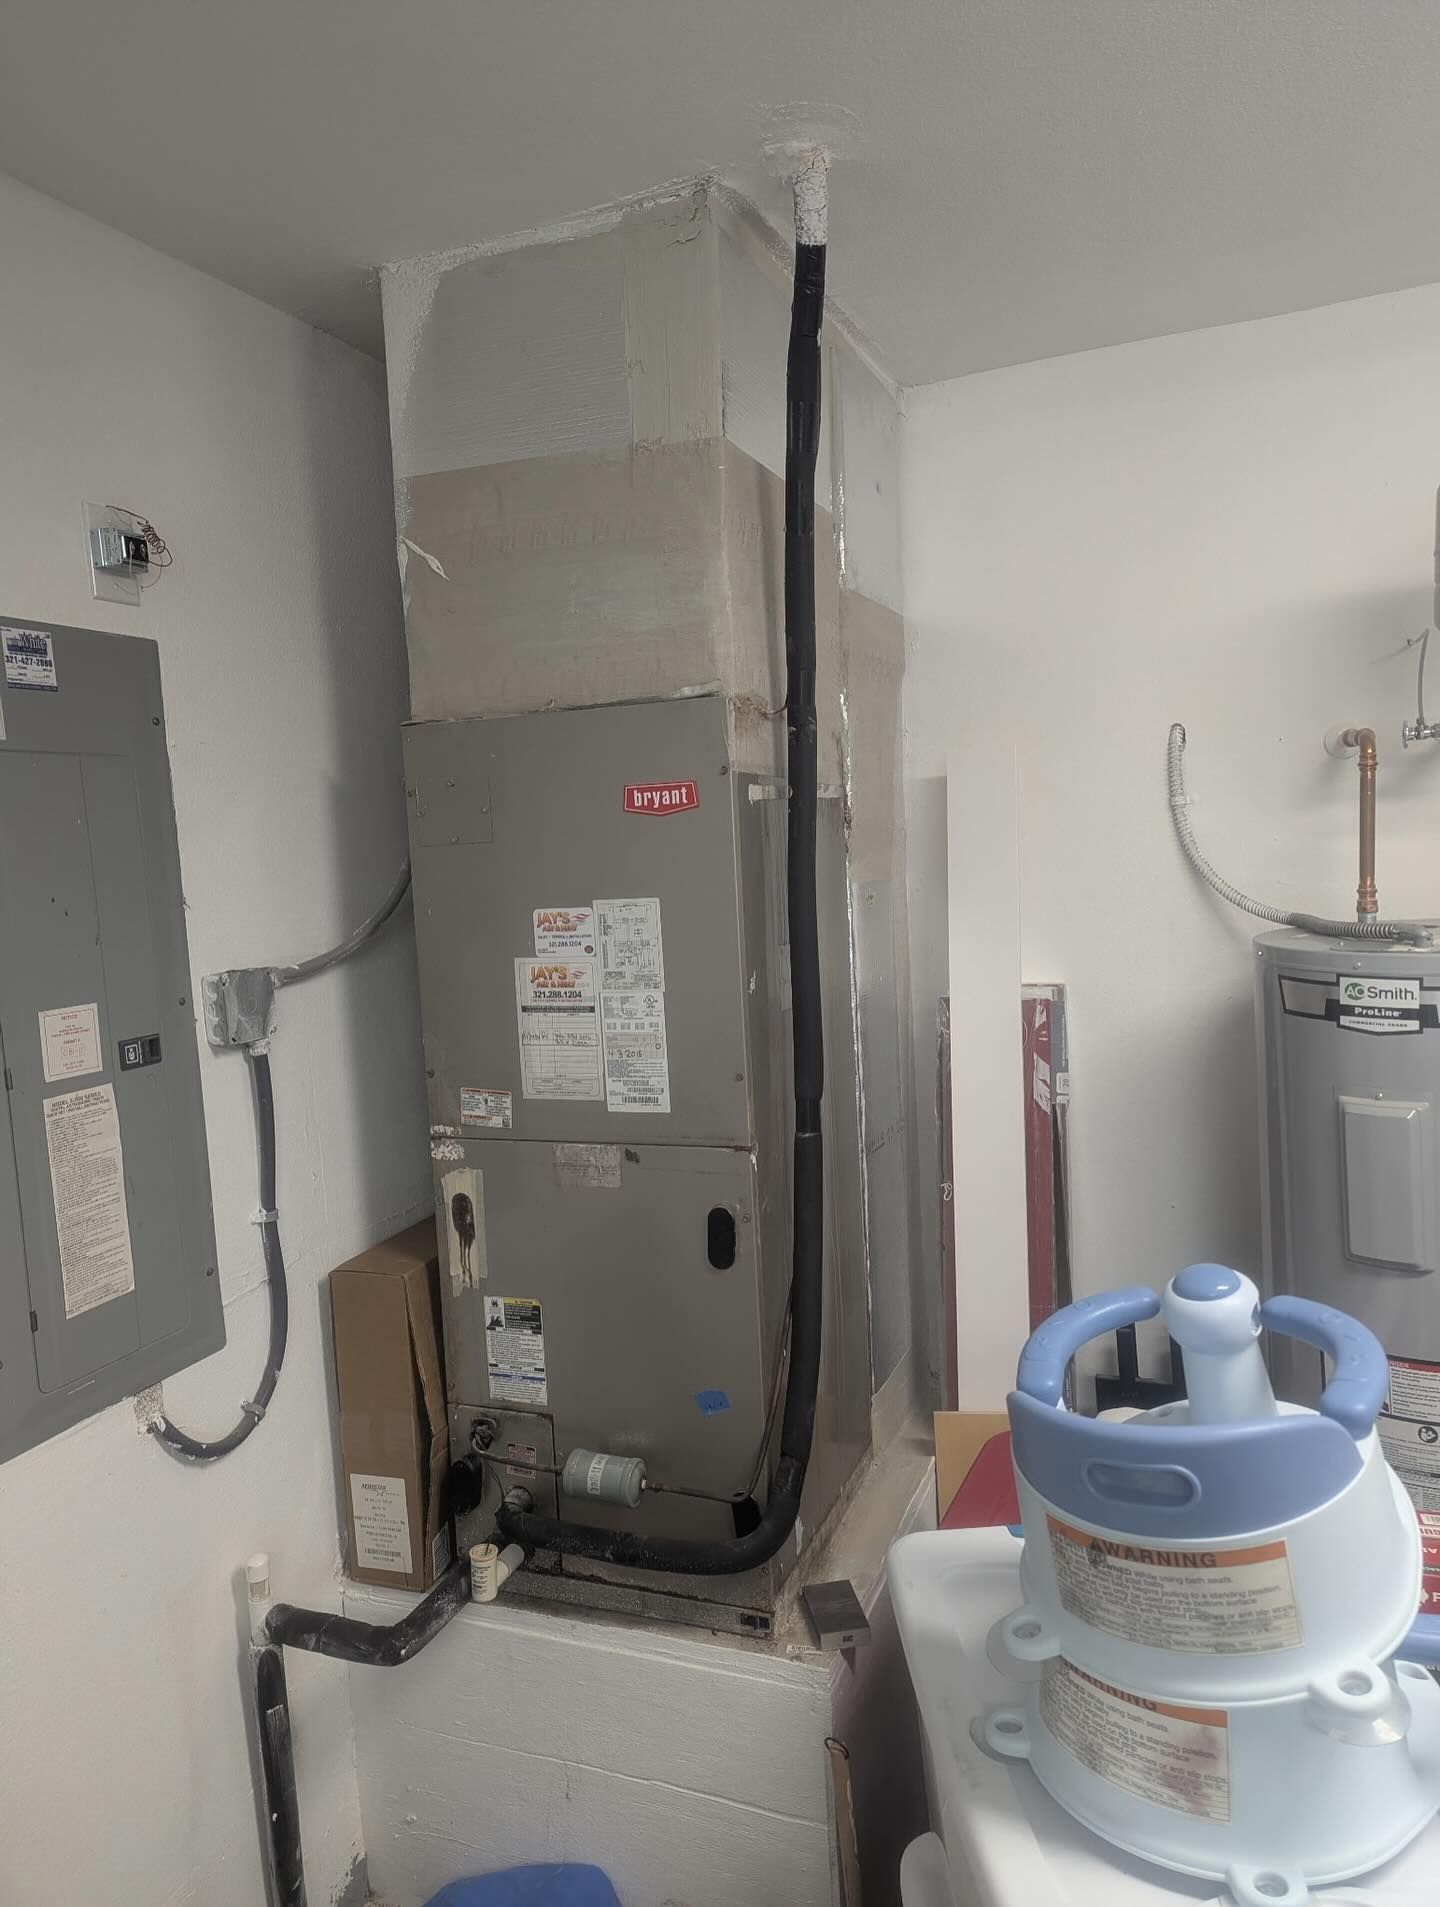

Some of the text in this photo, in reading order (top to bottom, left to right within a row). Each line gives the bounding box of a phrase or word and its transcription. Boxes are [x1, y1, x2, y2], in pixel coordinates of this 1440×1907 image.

[633, 787, 689, 809] bryant
[537, 911, 571, 928] JAY'S
[530, 966, 568, 983] JAY'S
[532, 990, 582, 999] 321.288.1204
[1354, 1007, 1399, 1017] ProLine
[1101, 1539, 1217, 1569] WARNING
